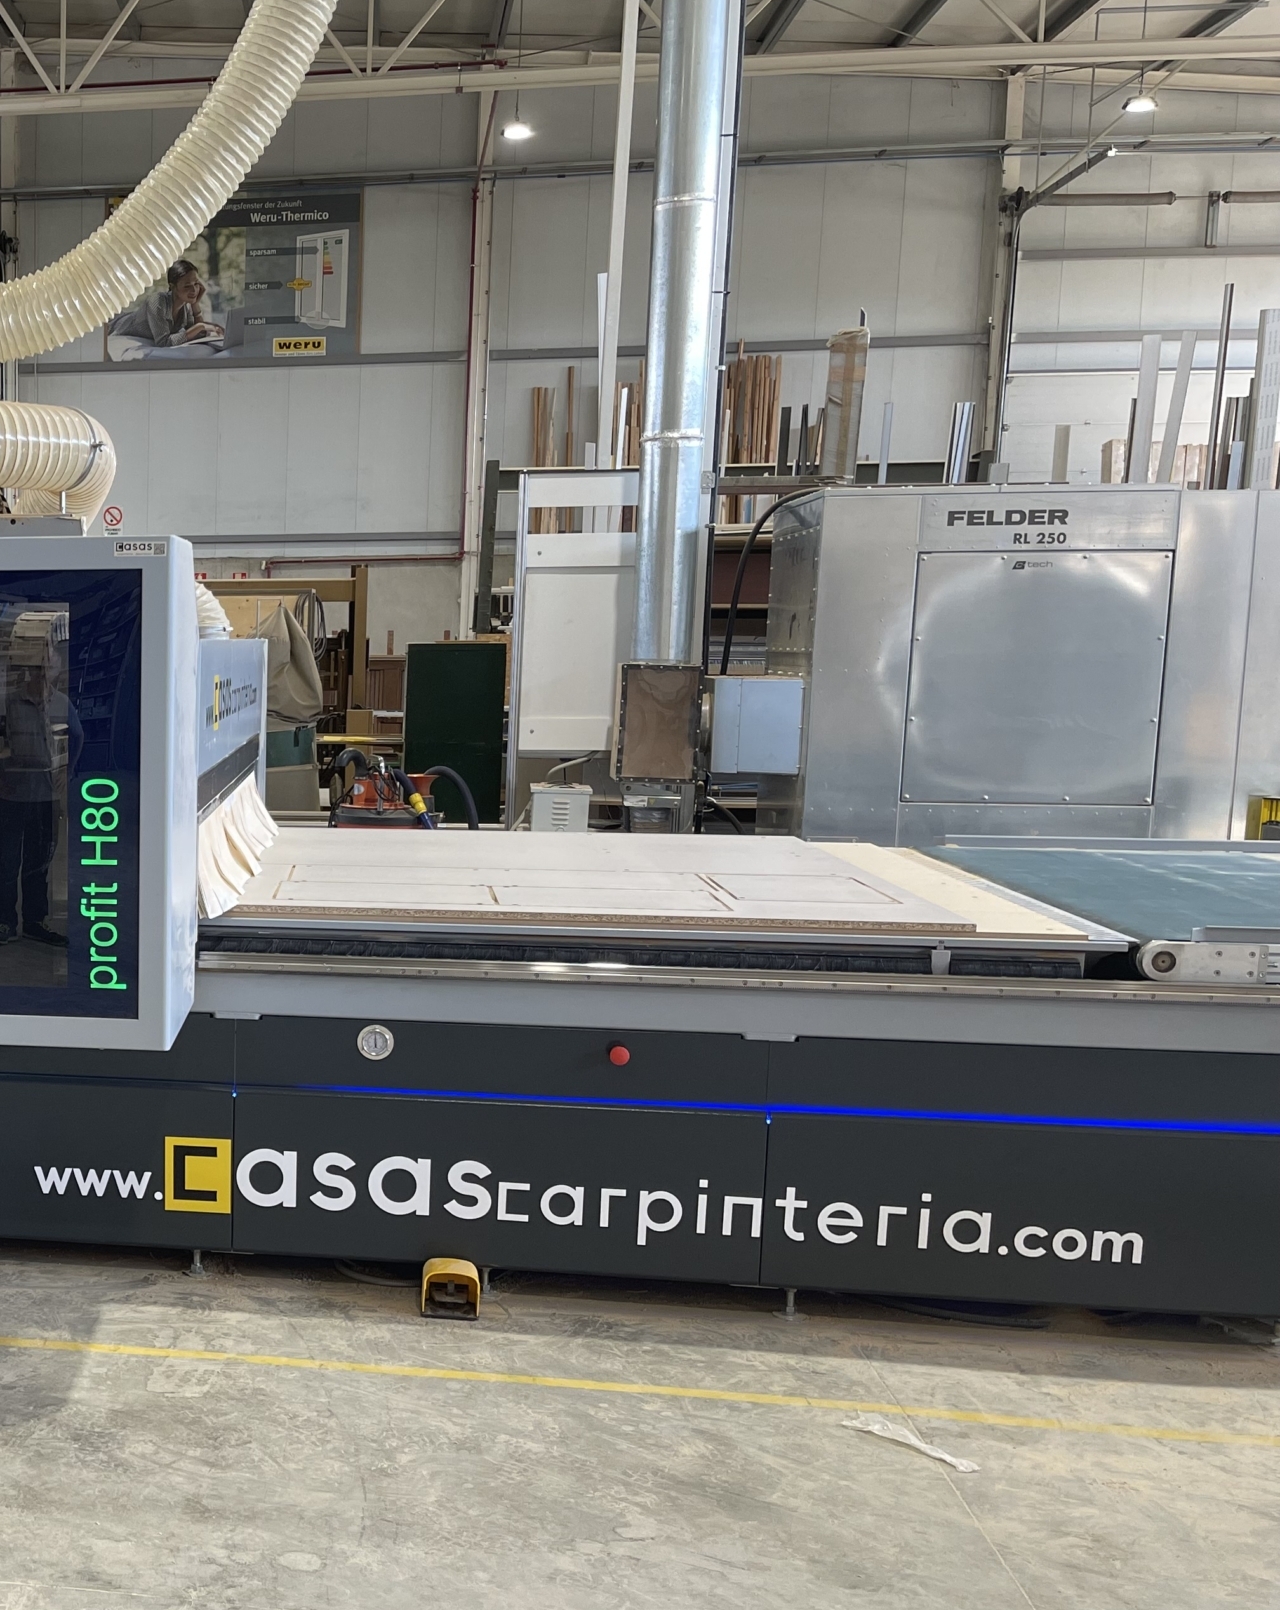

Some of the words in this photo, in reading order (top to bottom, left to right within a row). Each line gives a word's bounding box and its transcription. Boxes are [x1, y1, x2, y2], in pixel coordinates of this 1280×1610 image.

[265, 201, 276, 209] der
[277, 200, 302, 208] Zukunft
[250, 210, 329, 223] Weru-Thermico
[249, 249, 277, 257] sparsam
[248, 282, 268, 290] sicher
[248, 317, 266, 325] stabil
[278, 341, 321, 350] weru
[947, 509, 1069, 526] FELDER
[1013, 533, 1030, 544] RL
[1036, 532, 1067, 544] 250
[80, 778, 119, 866] H80
[80, 882, 127, 990] profit
